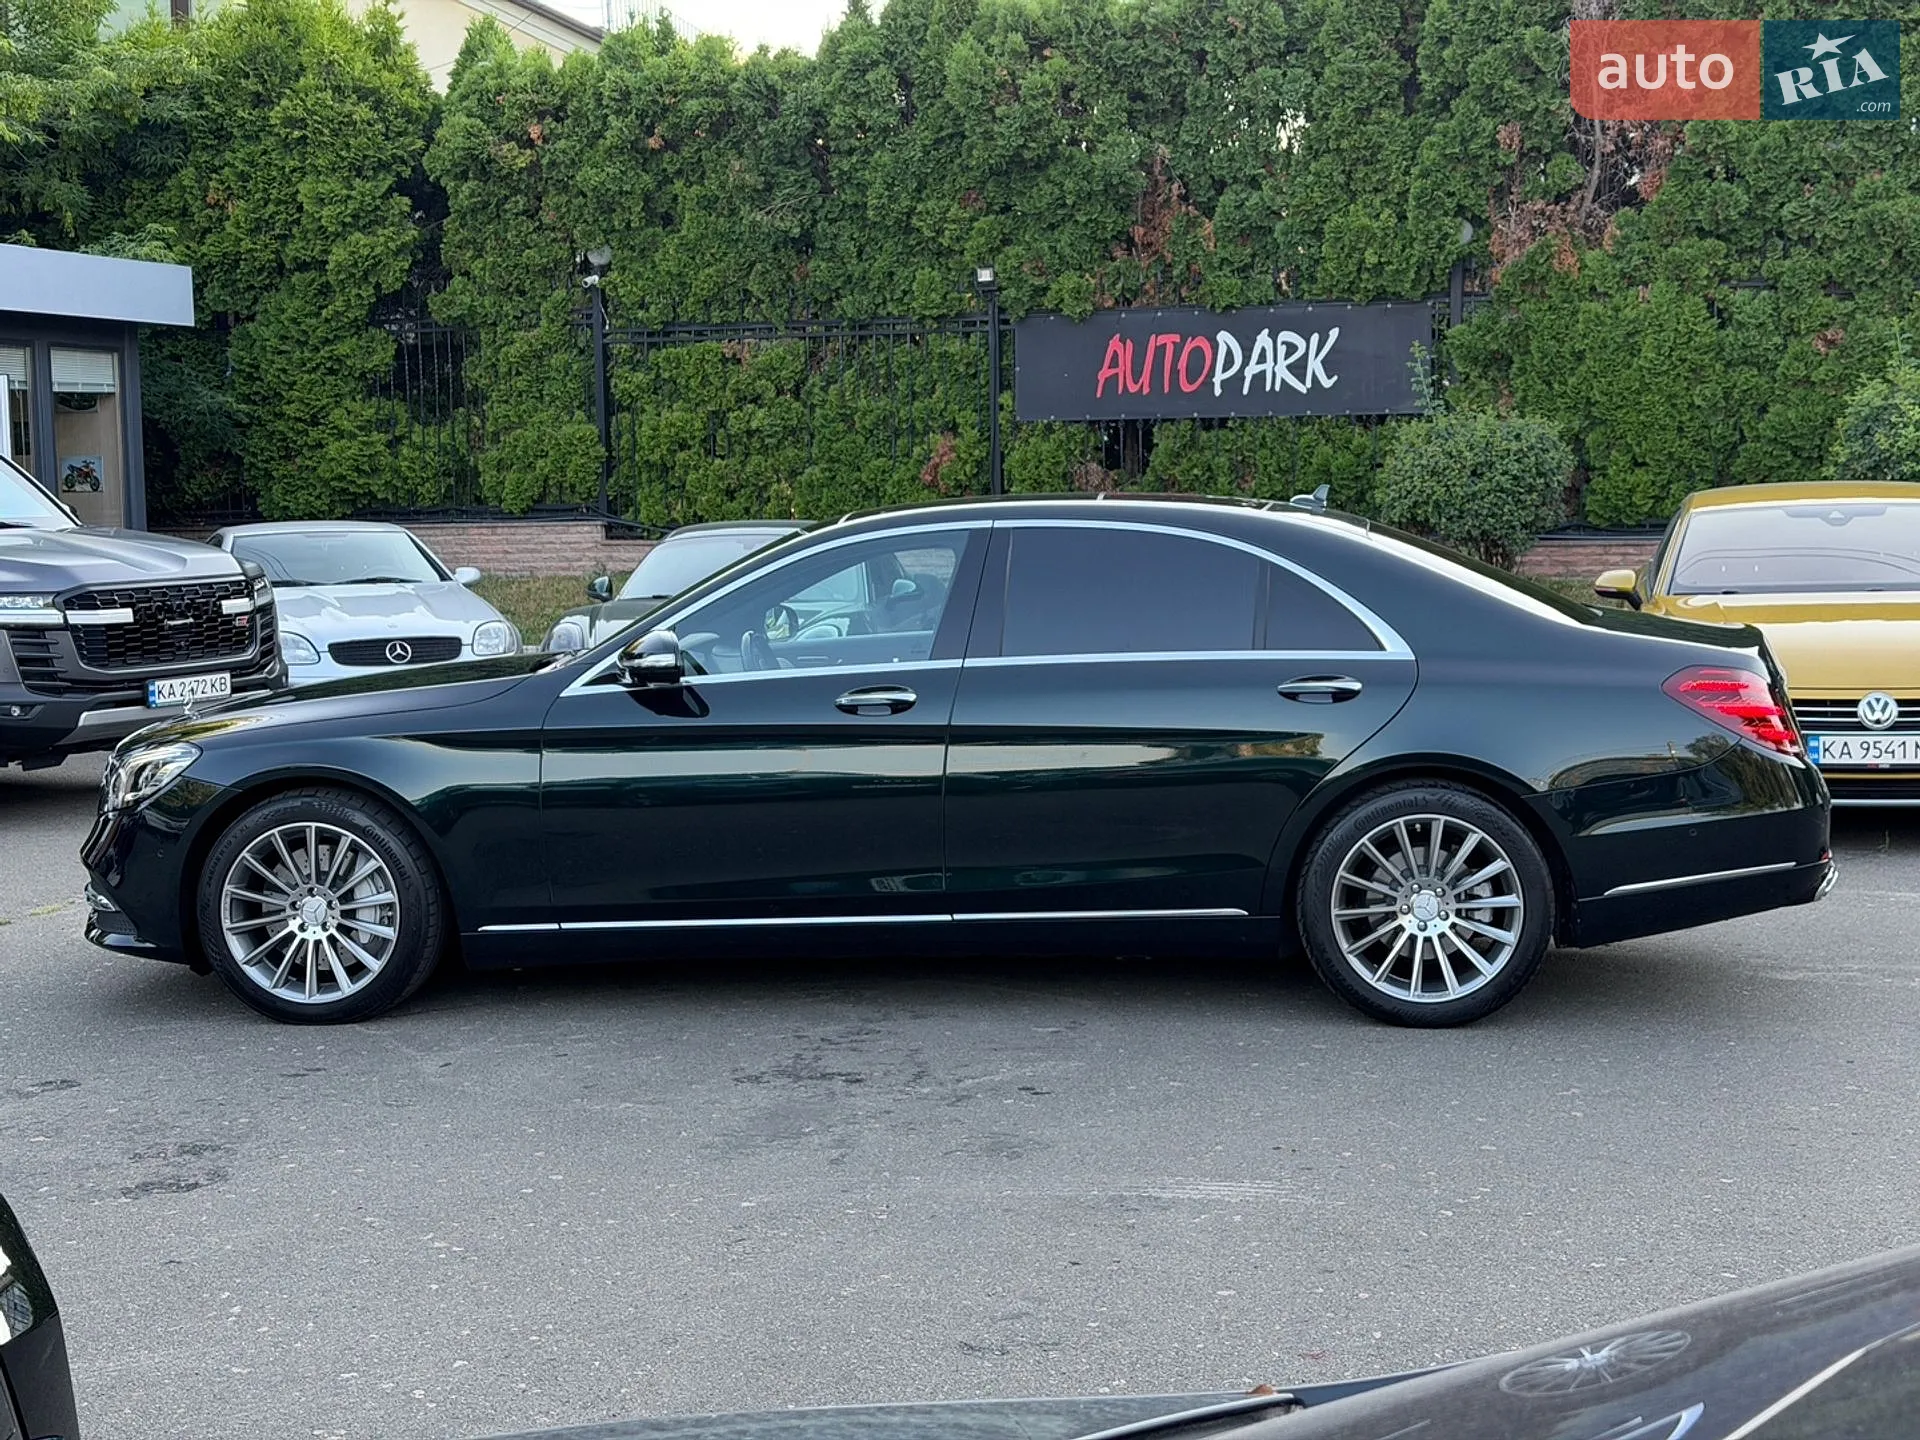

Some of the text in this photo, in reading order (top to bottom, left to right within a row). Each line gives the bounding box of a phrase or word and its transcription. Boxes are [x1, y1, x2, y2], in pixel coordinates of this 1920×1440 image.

[1096, 326, 1340, 398] AUTOPARK
[157, 683, 176, 700] KA
[210, 676, 227, 693] KB
[1822, 740, 1852, 759] KA
[1860, 740, 1907, 759] 9541
[362, 824, 412, 881] Continental
